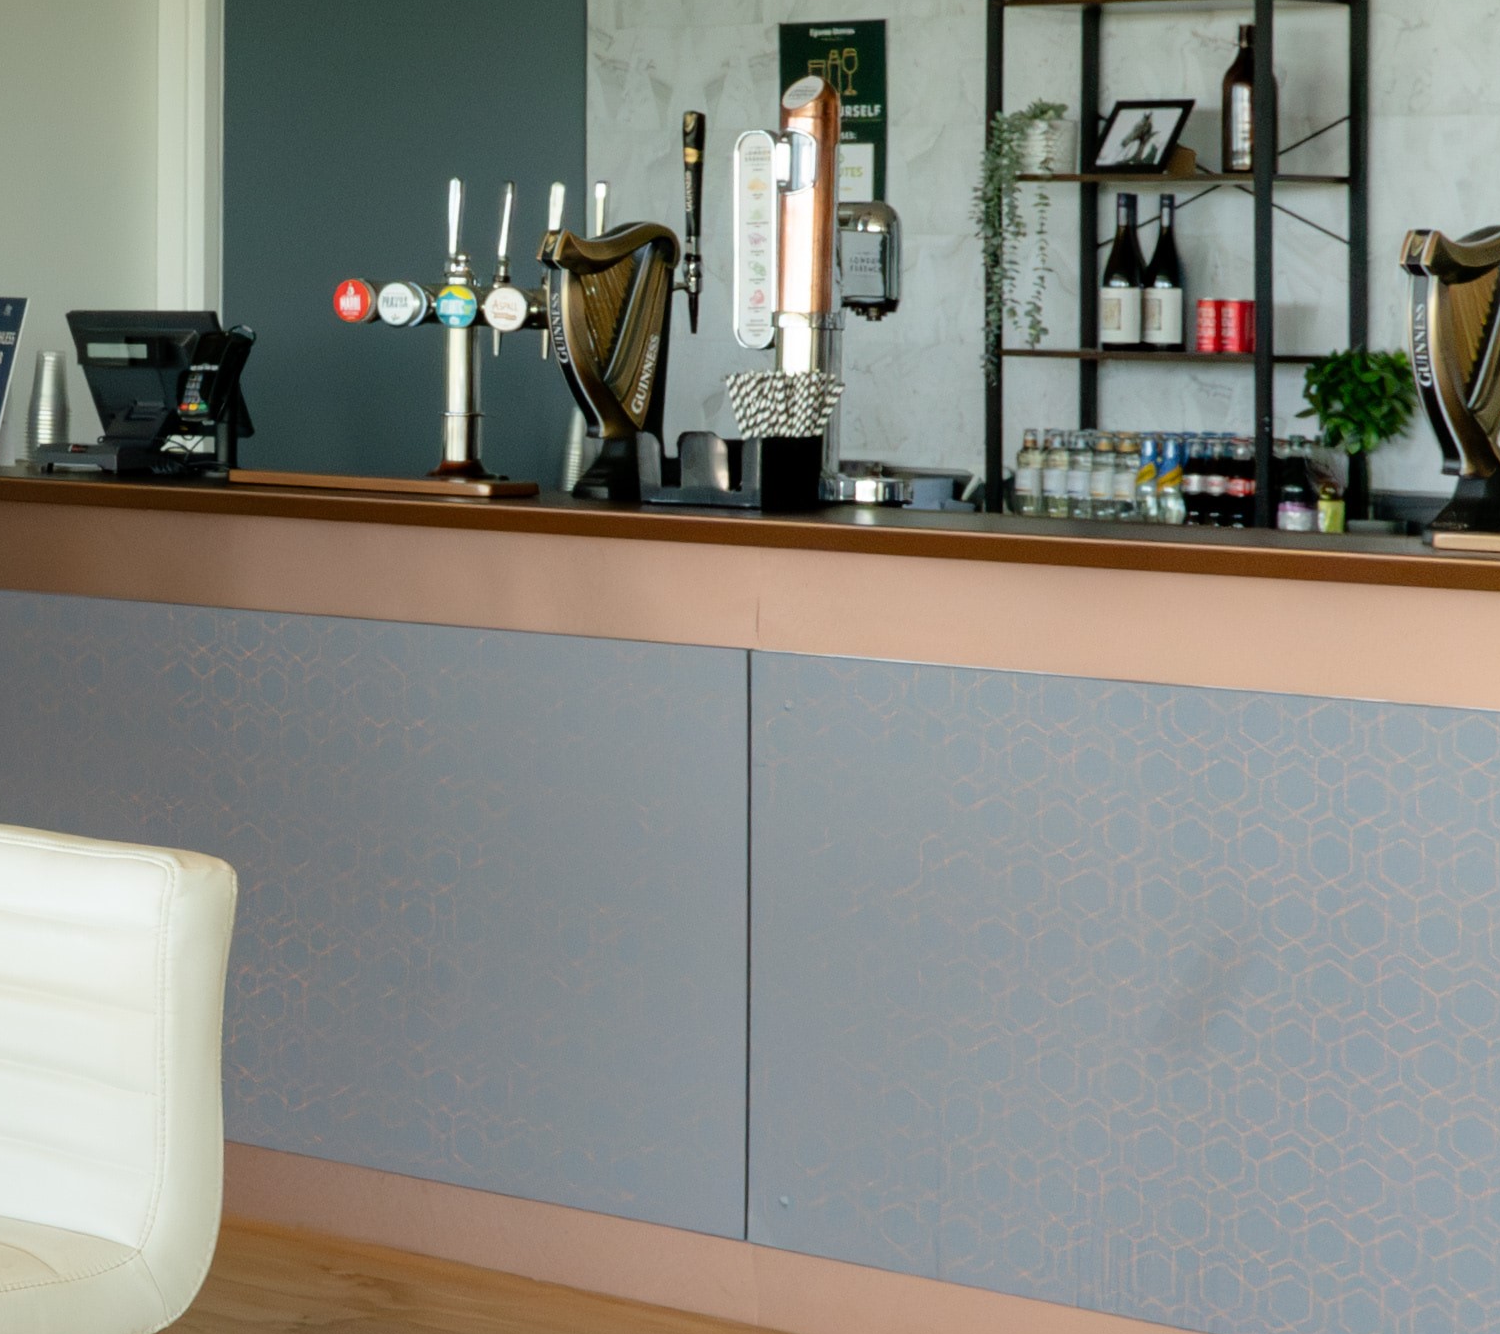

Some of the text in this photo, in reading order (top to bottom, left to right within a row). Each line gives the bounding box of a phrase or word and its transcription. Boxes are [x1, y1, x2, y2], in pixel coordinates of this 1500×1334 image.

[551, 292, 569, 364] GUINNESS
[1414, 303, 1433, 387] GUINNESS
[631, 334, 660, 415] GUINNESS
